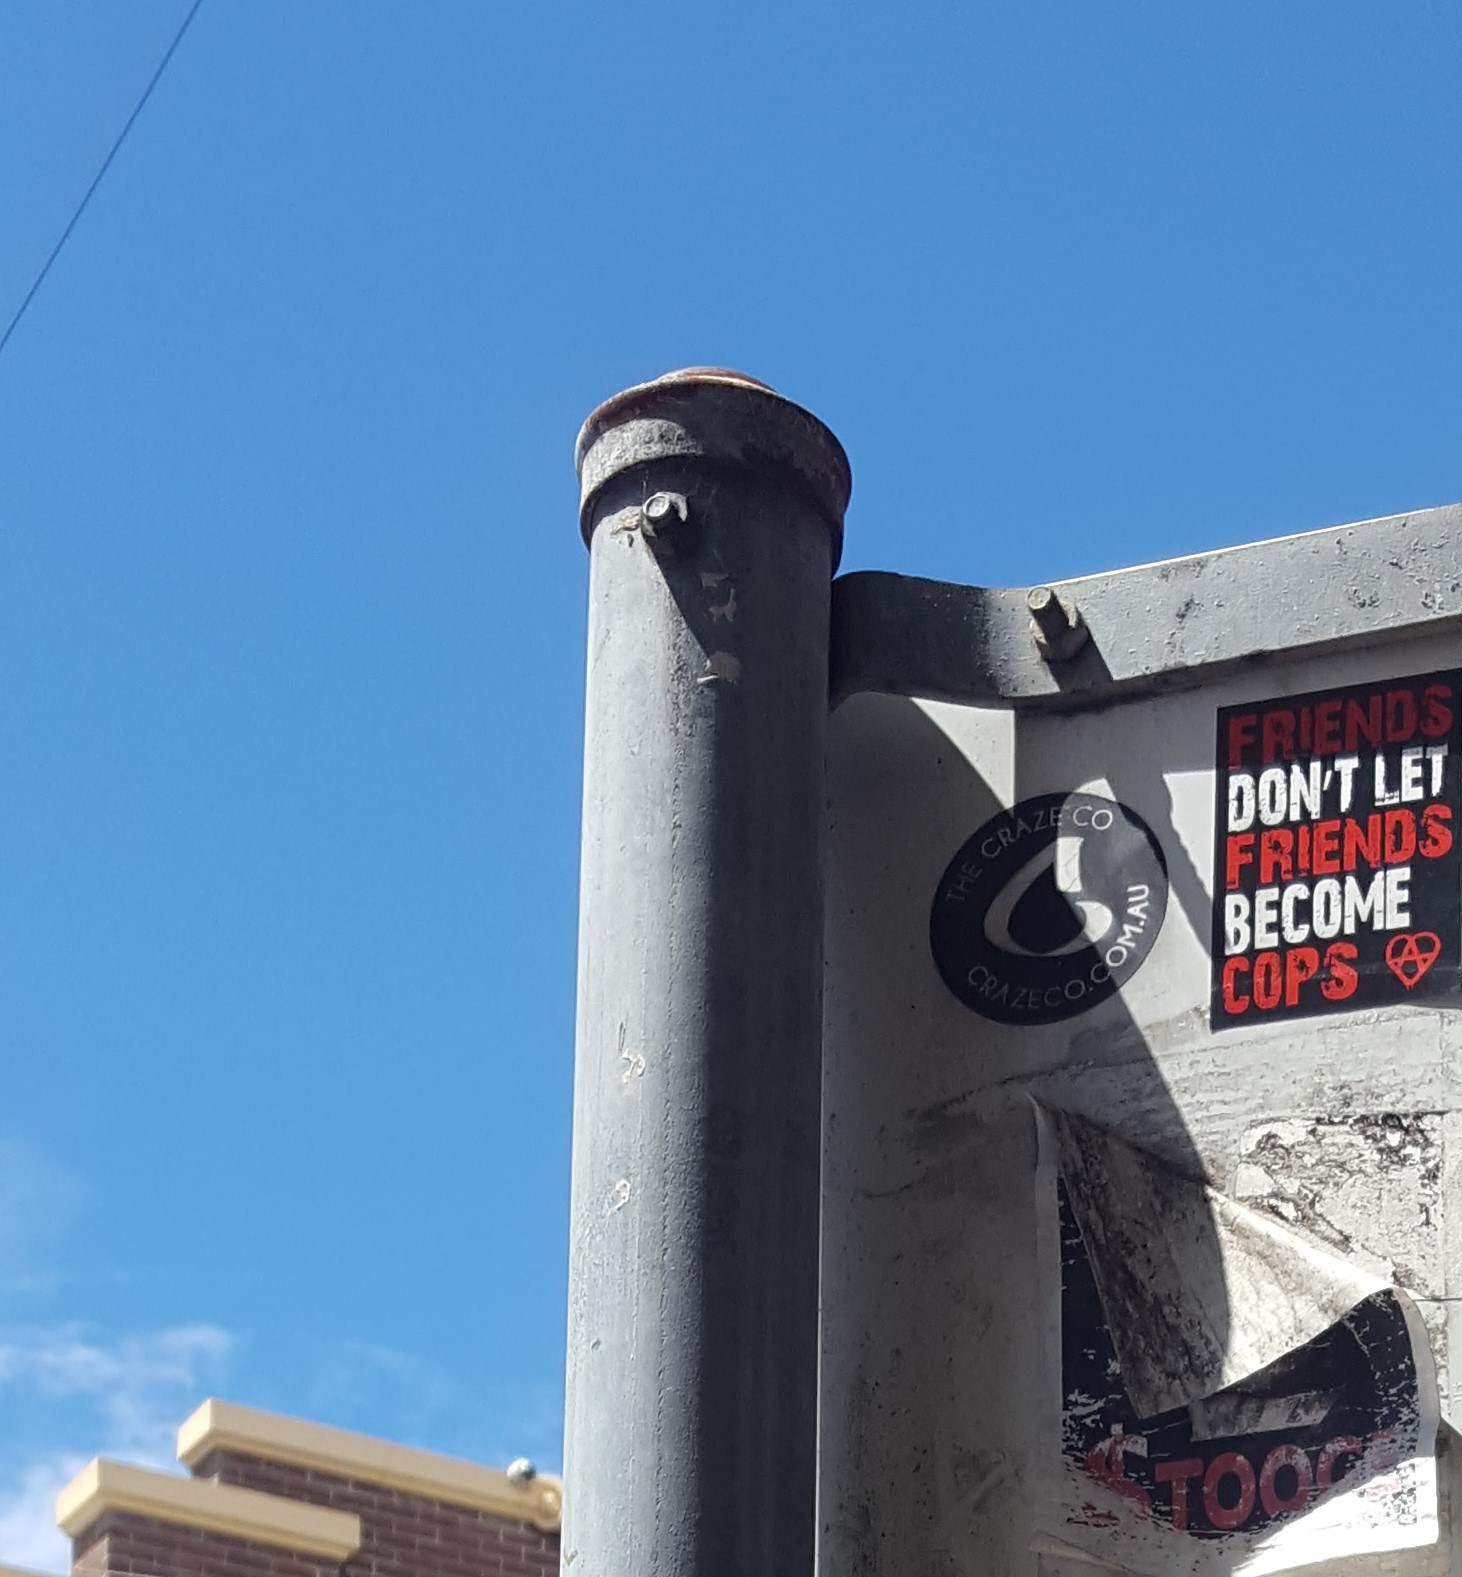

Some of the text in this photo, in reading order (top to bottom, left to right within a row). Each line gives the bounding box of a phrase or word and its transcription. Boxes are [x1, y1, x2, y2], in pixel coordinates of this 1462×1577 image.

[1227, 683, 1454, 770] FRIENDS
[1227, 742, 1449, 834] DON'T LET
[945, 805, 1114, 903] THE CRAZE CO
[1225, 802, 1453, 890] FRIENDS
[968, 883, 1150, 1010] CRAZECO.COM.AU
[1223, 865, 1411, 956] BECOME
[1221, 941, 1360, 1017] COPS
